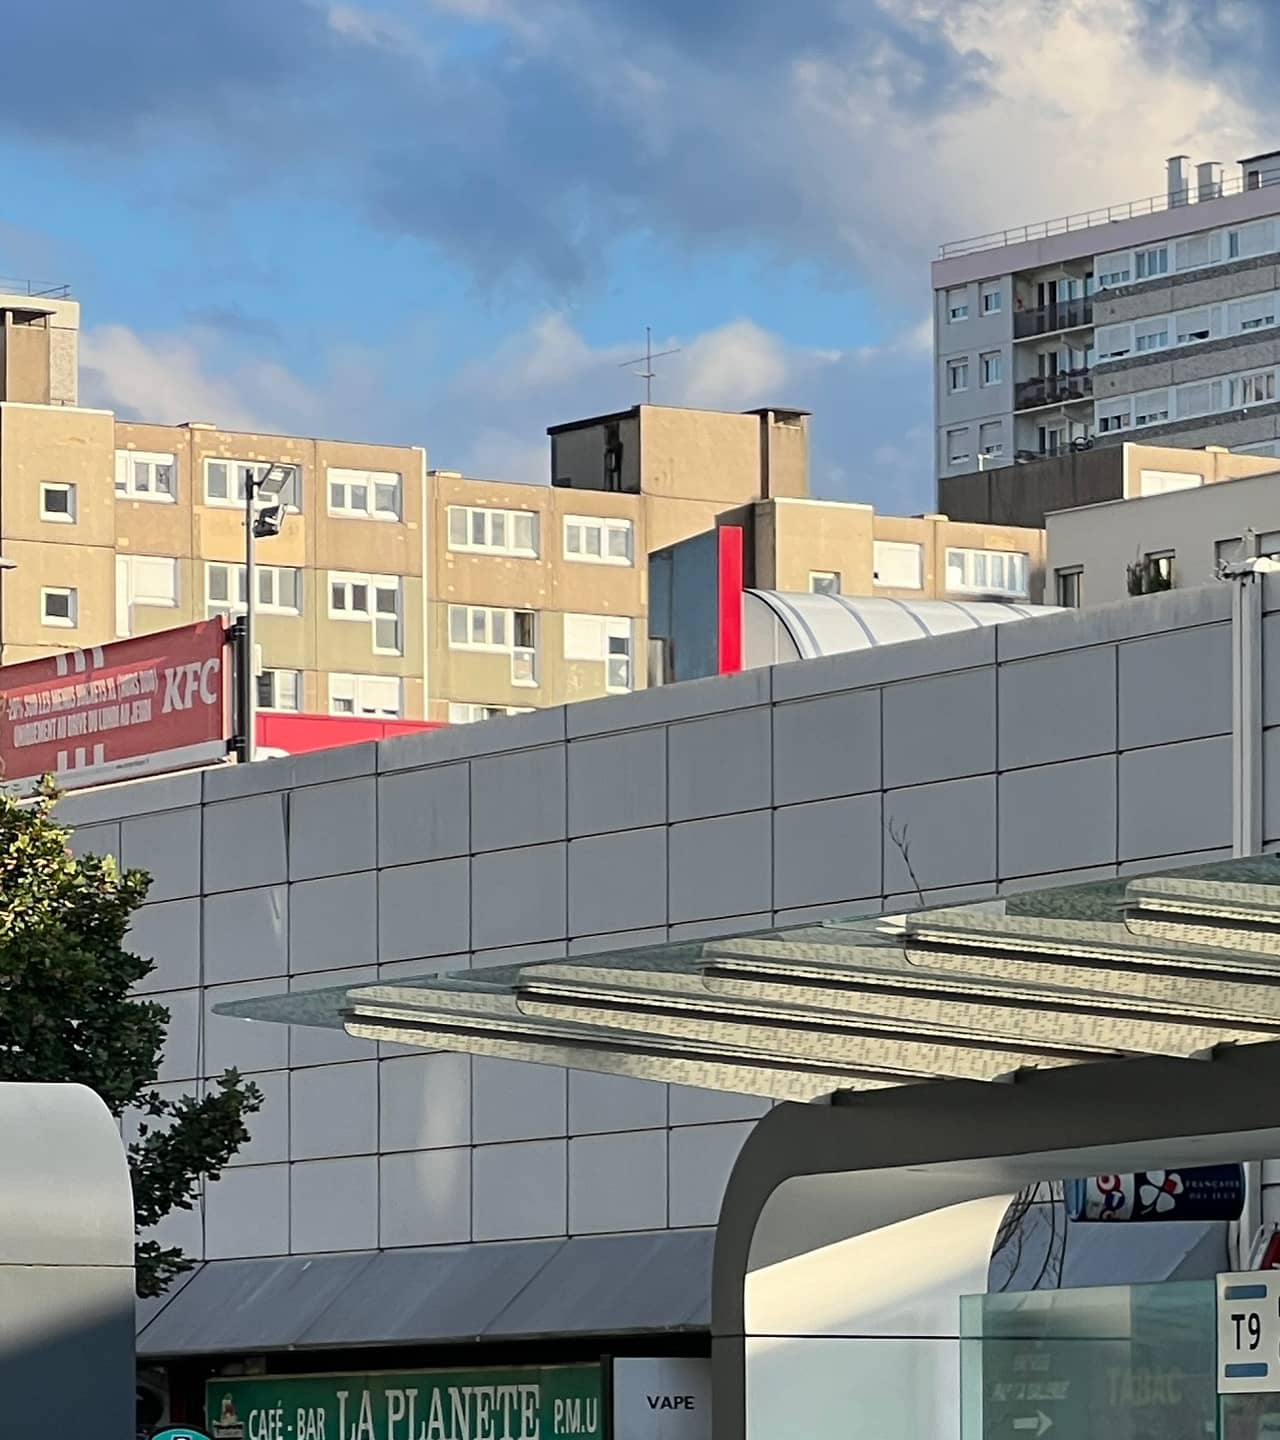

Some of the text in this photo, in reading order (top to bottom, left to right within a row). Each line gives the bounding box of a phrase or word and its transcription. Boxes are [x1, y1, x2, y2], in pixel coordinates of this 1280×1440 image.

[161, 657, 221, 714] KFC
[1230, 1311, 1262, 1351] T9
[646, 1395, 696, 1411] VAPE
[296, 1407, 326, 1440] BAR
